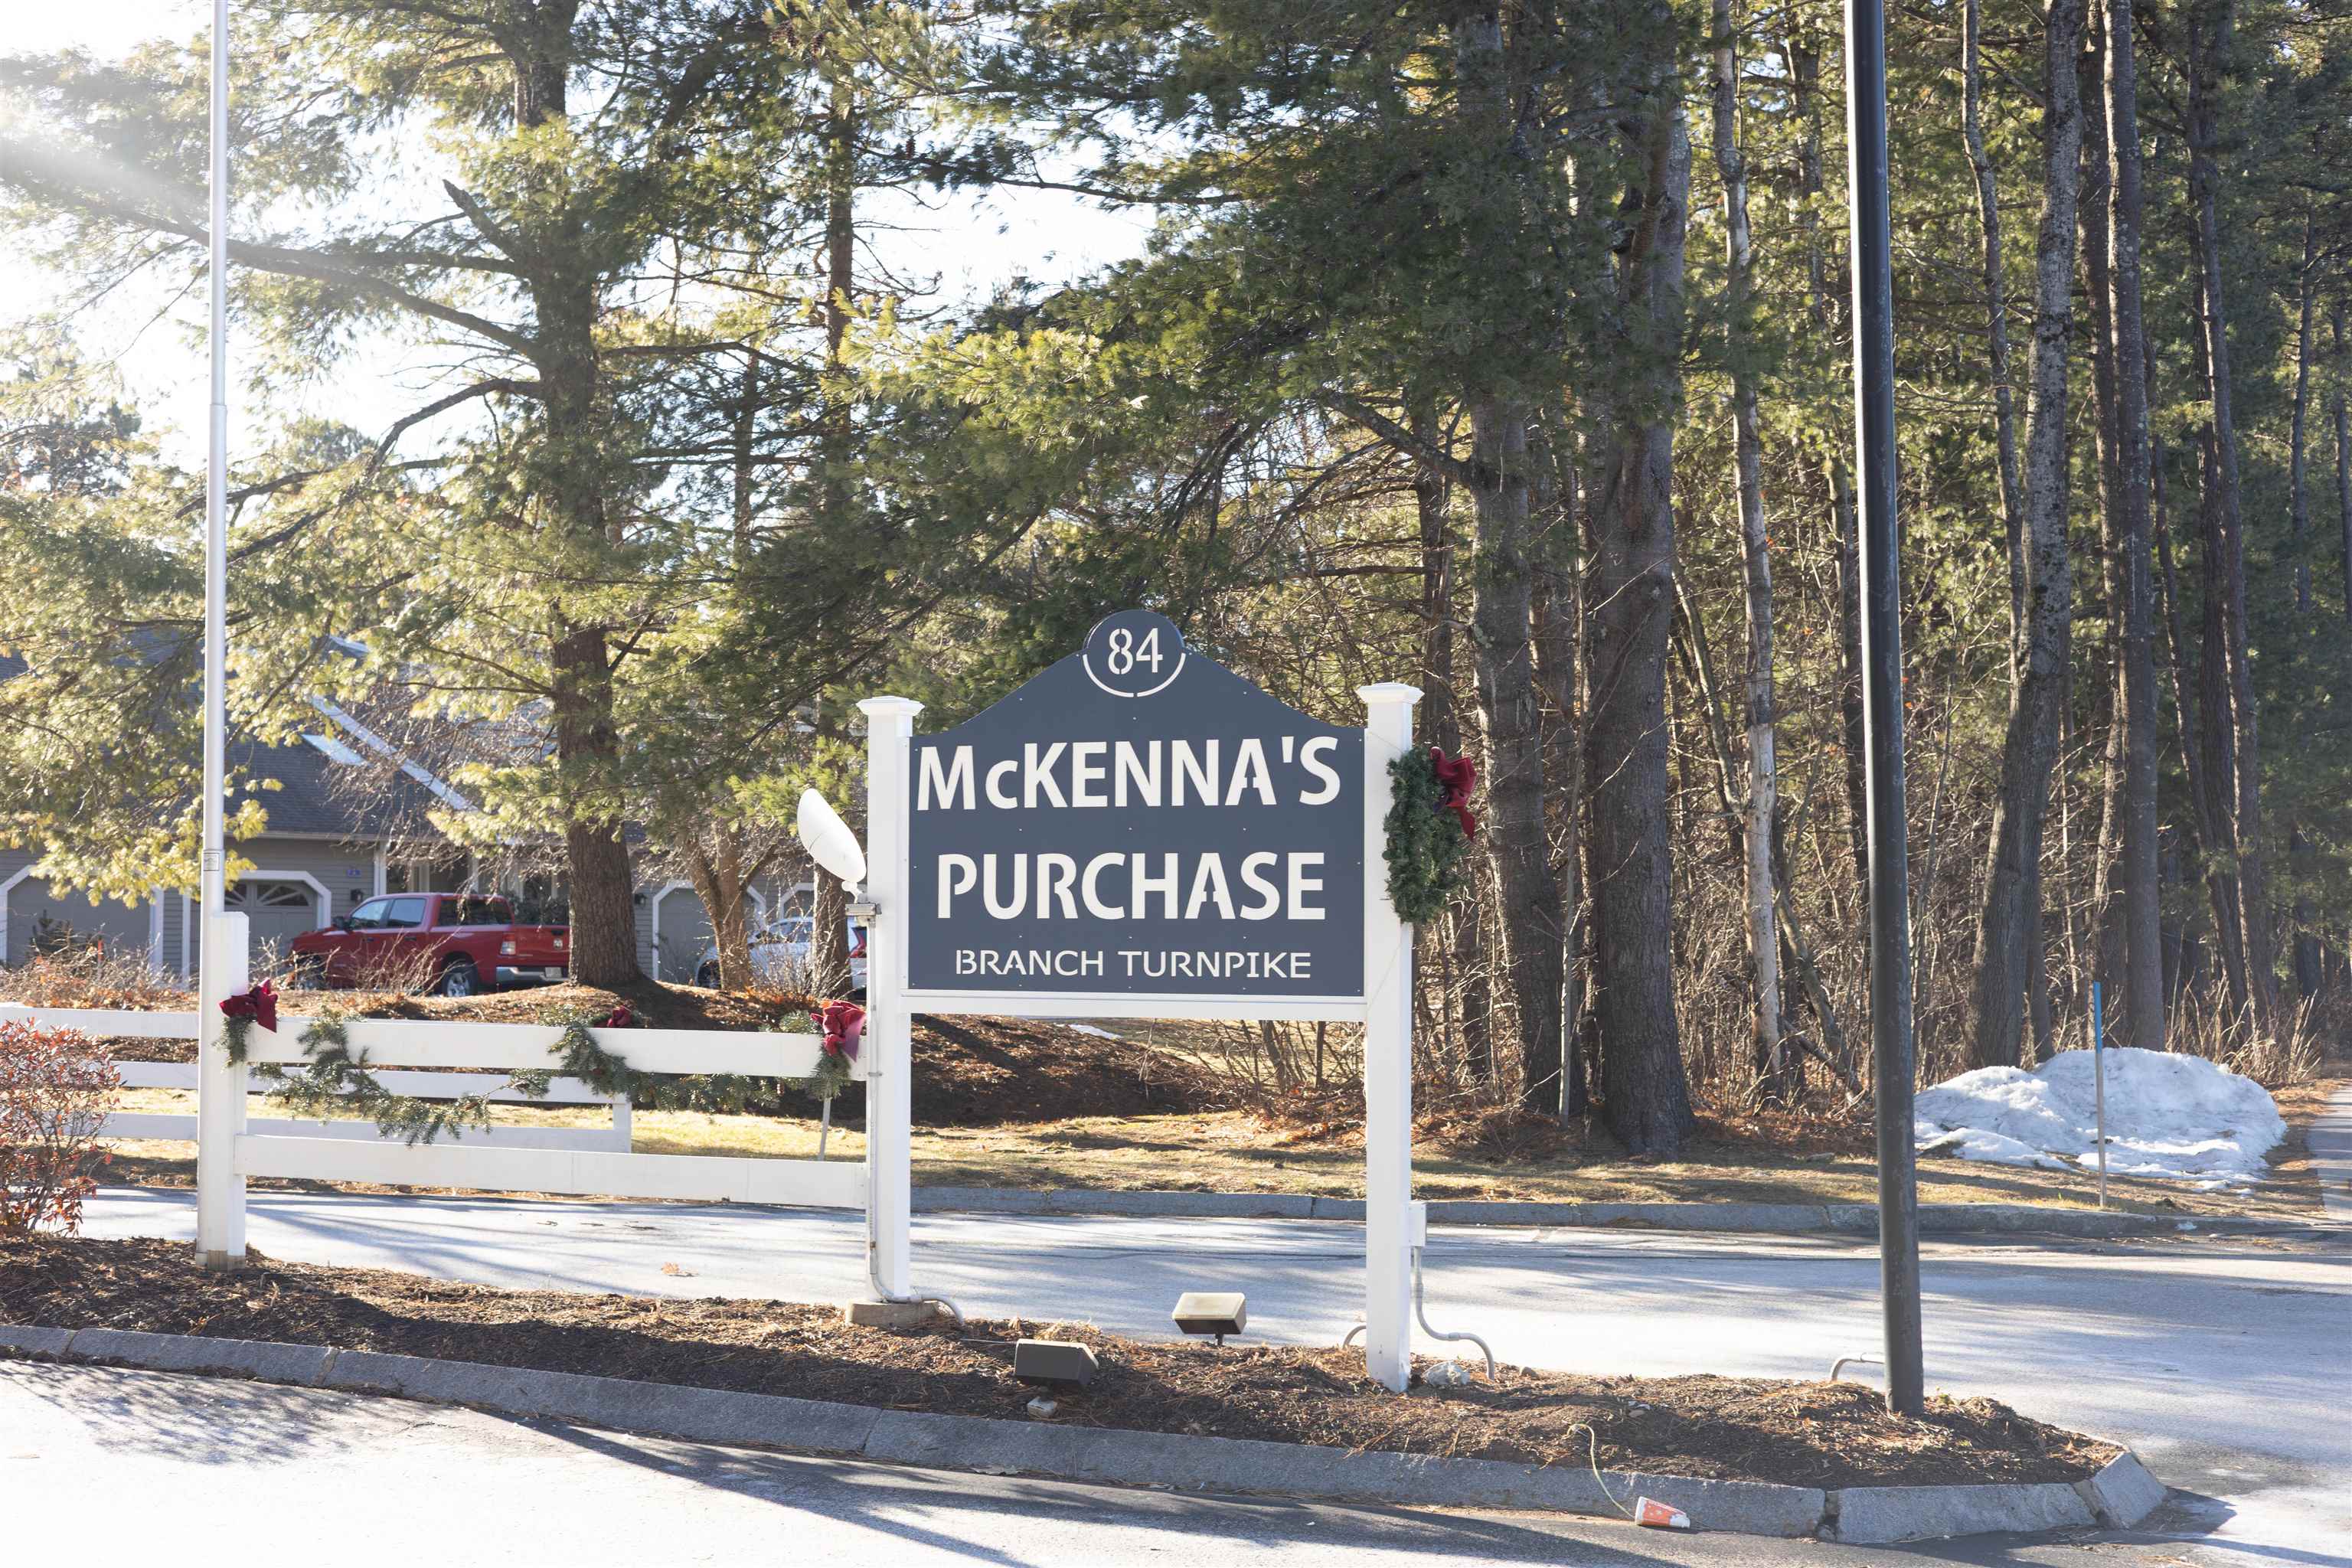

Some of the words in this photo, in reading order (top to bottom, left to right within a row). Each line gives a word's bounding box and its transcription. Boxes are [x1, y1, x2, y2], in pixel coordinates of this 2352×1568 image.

[1108, 628, 1163, 675] 84
[917, 736, 1341, 811] McKENNA'S
[938, 851, 1325, 920] PURCHASE
[956, 949, 1103, 976] BRANCH
[1118, 951, 1311, 978] TURNPIKE
